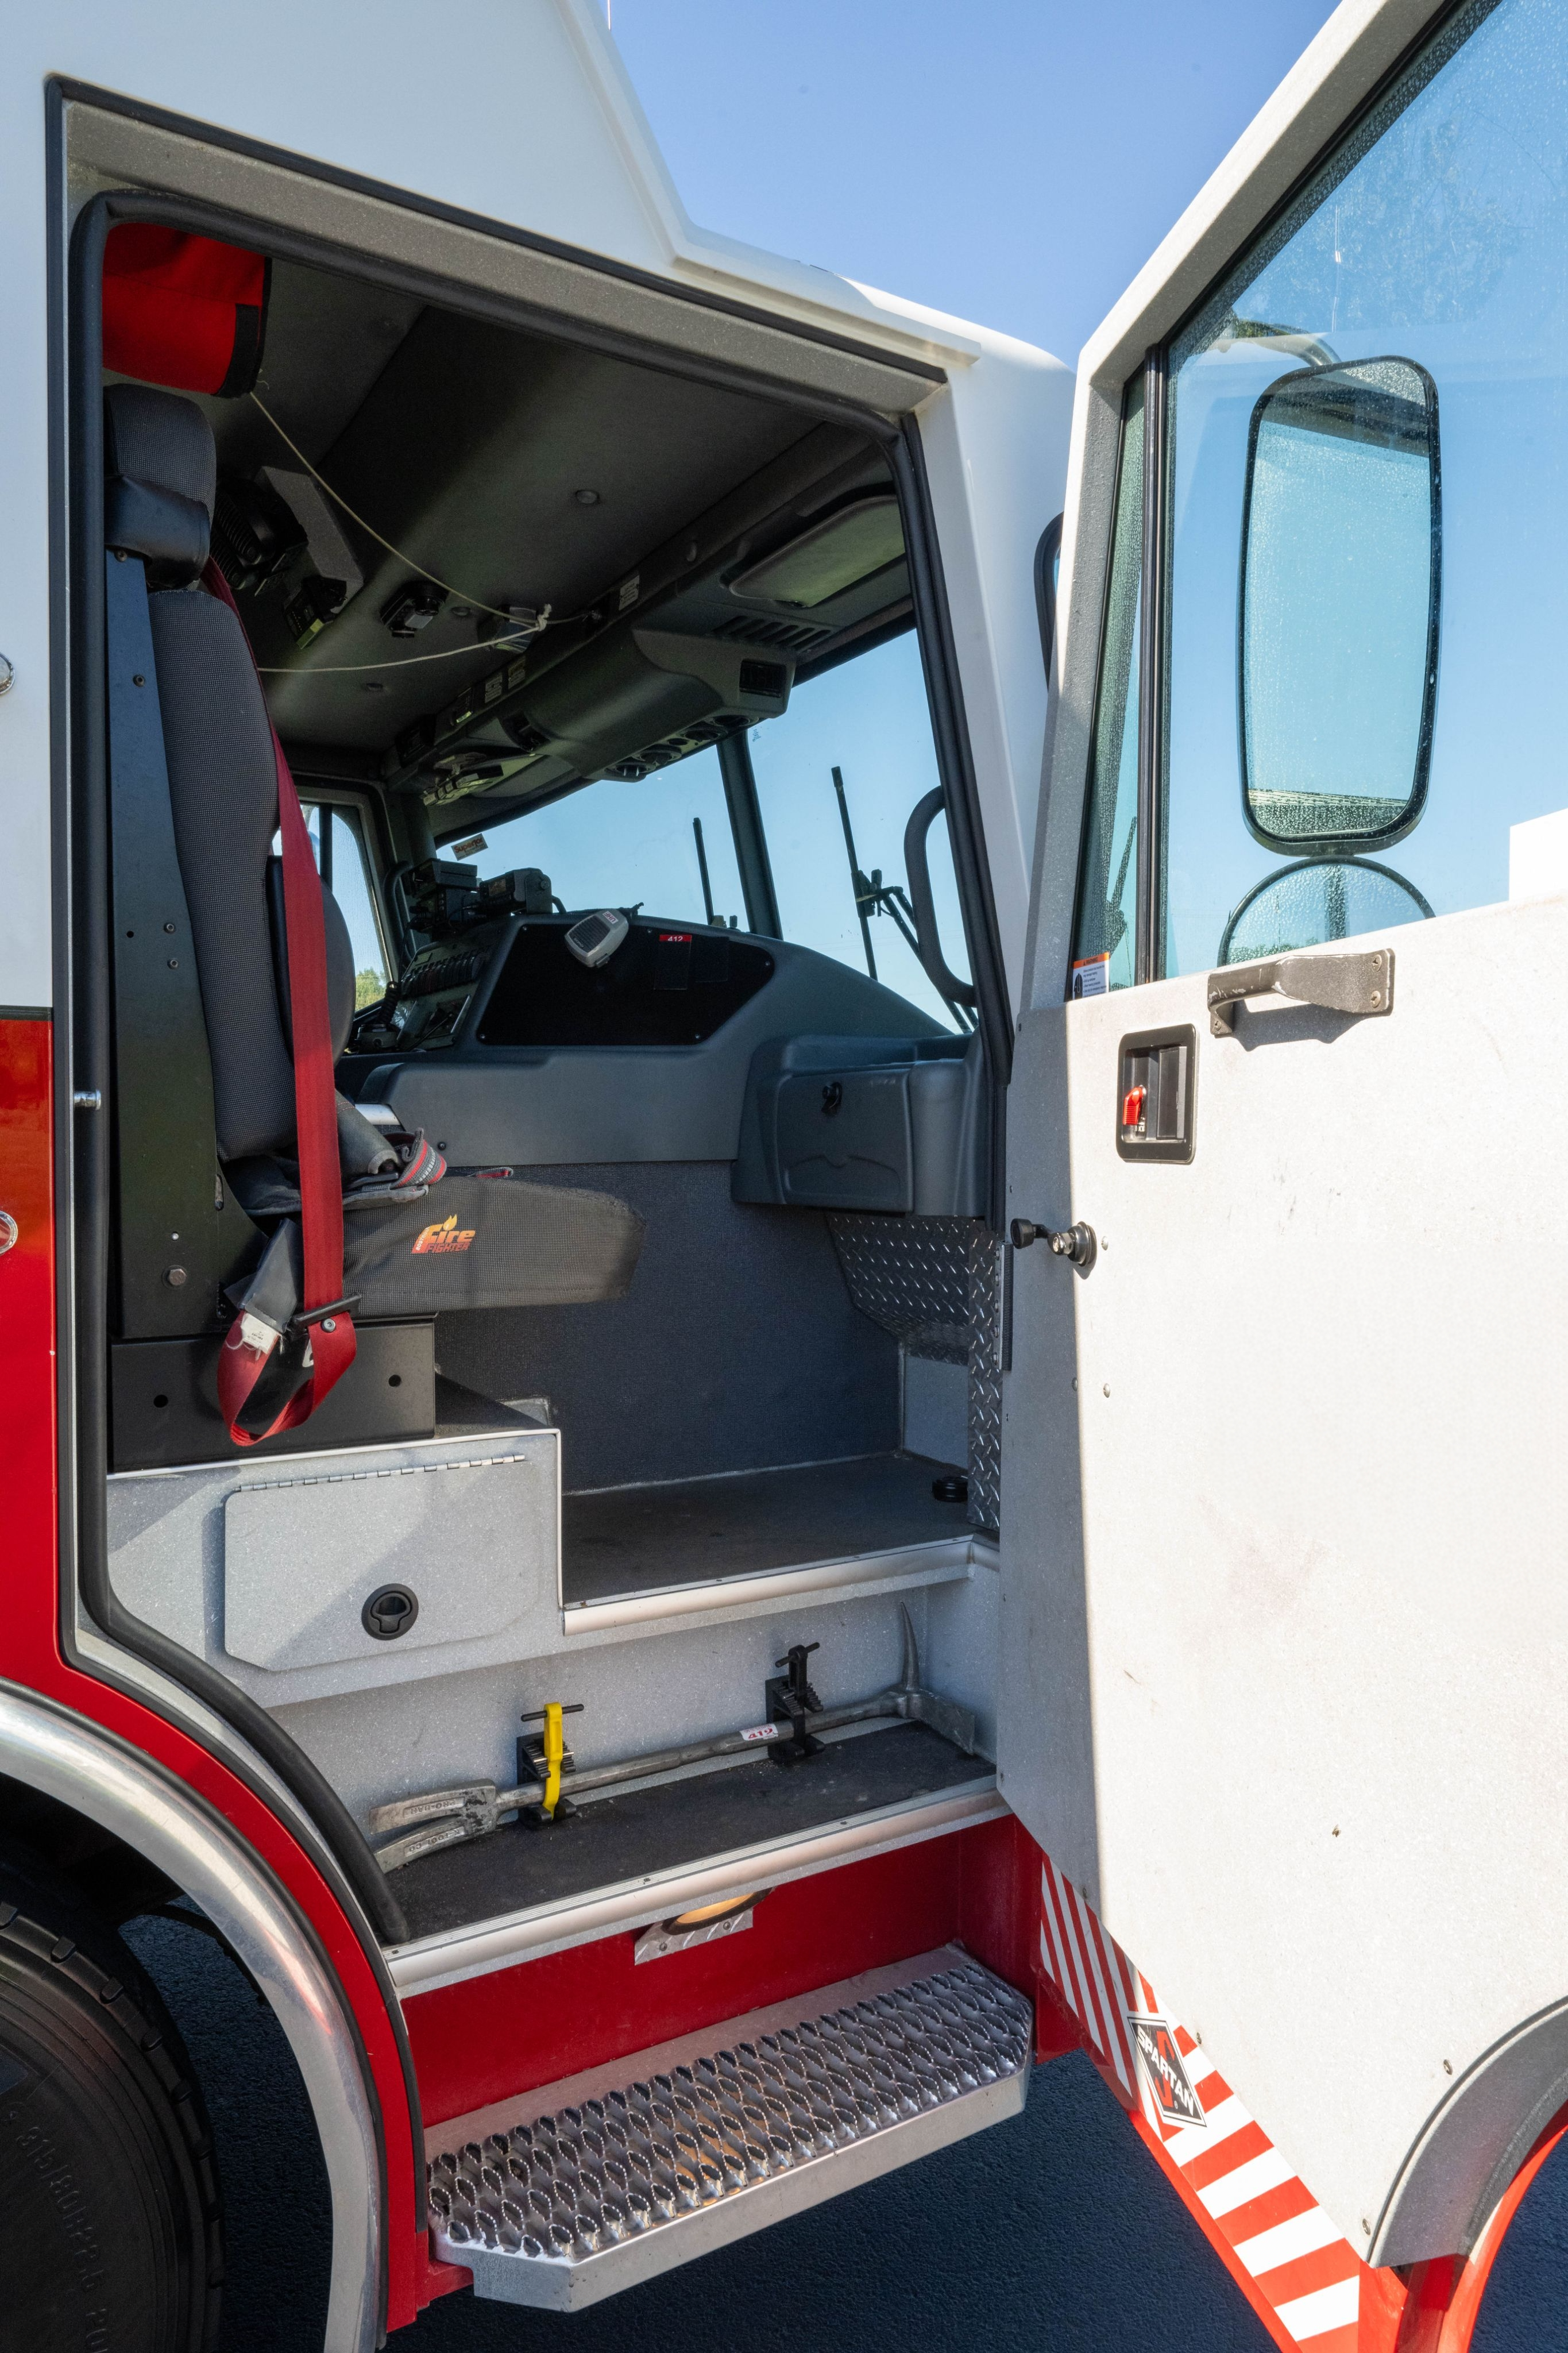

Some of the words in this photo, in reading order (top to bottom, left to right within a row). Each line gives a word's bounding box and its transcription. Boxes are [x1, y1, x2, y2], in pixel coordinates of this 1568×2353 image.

[604, 913, 616, 923] UHF
[422, 1215, 476, 1245] Fire
[426, 1243, 471, 1253] FIGHTER
[1137, 2024, 1195, 2116] SPARTAN
